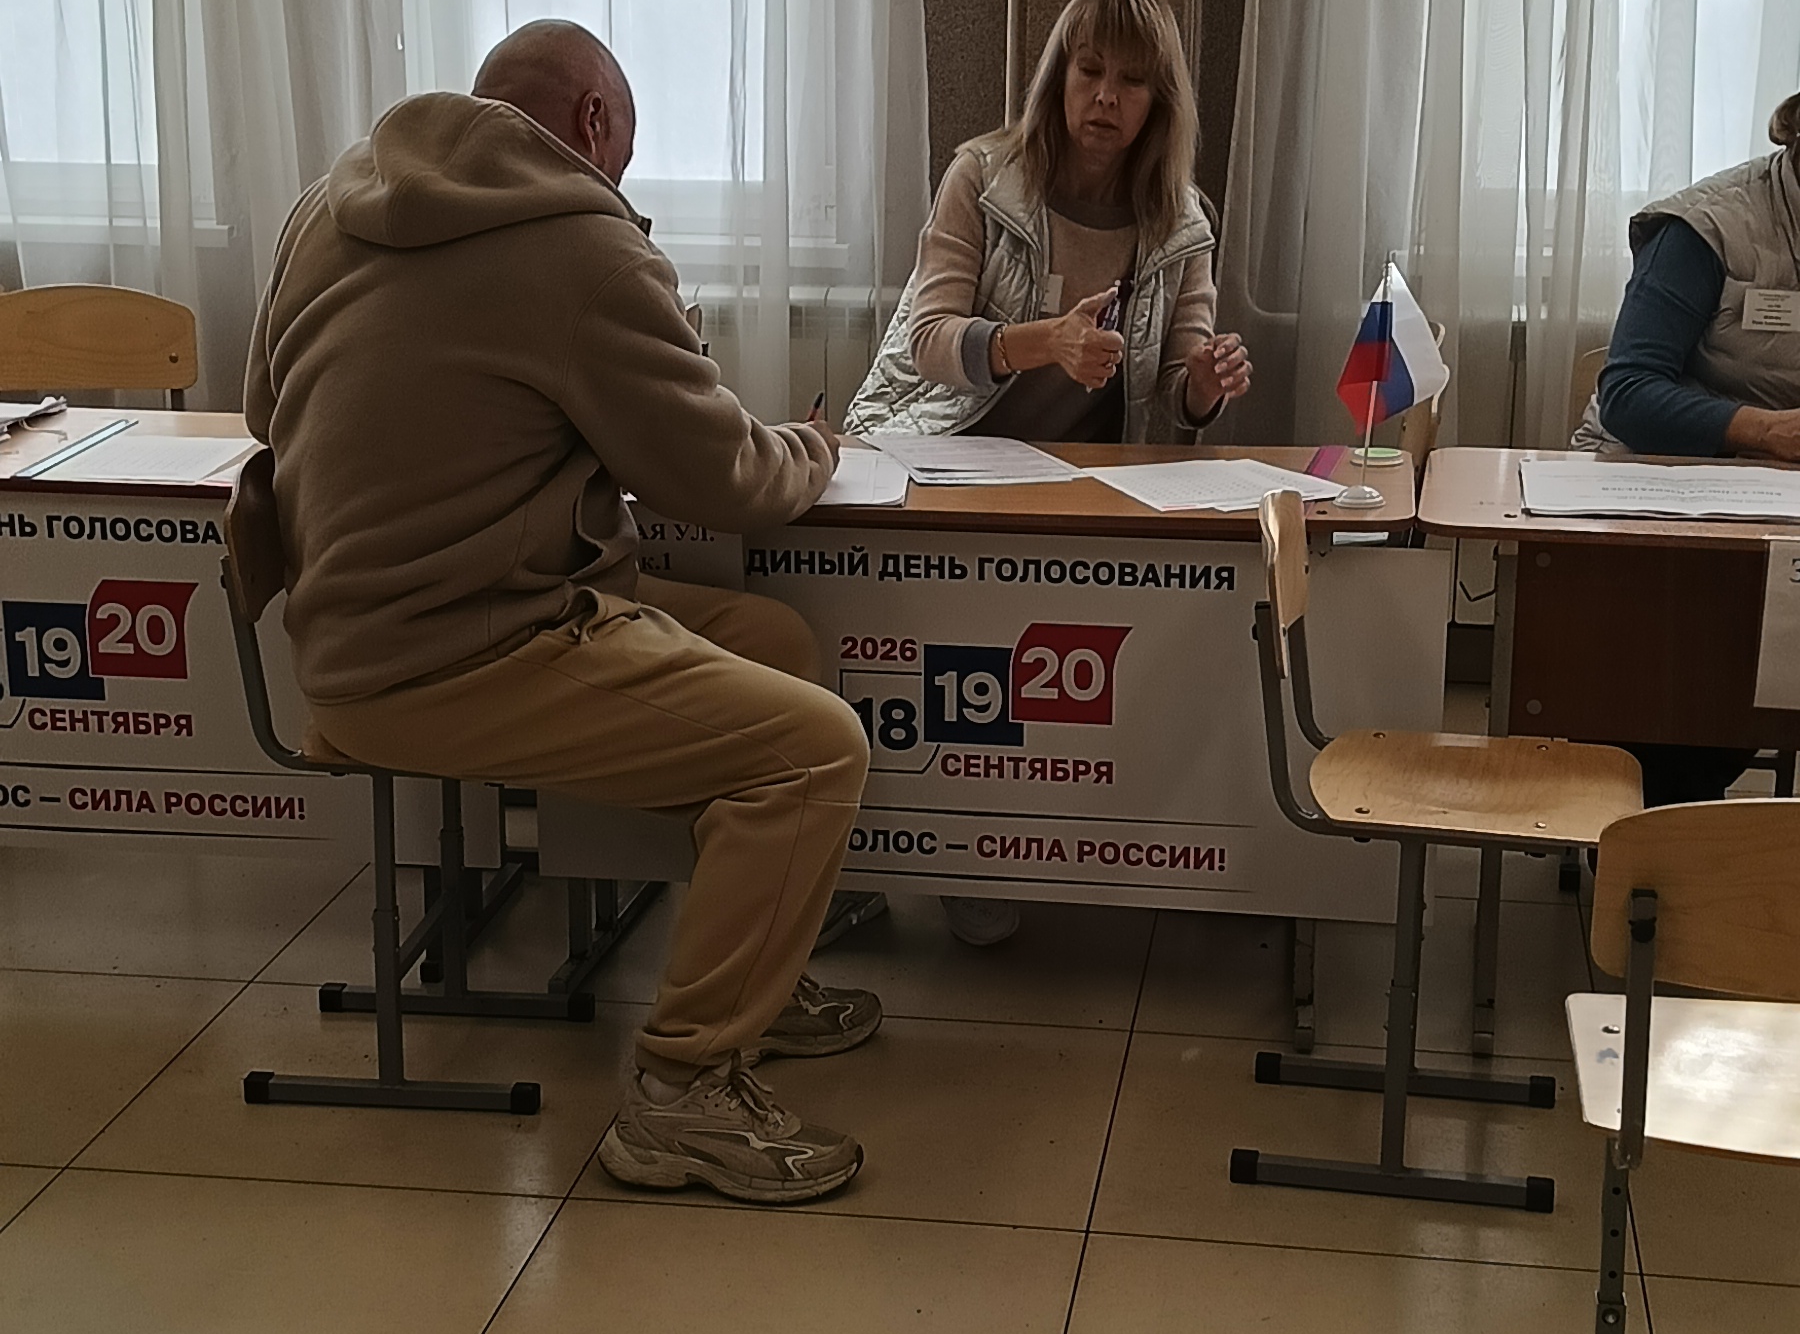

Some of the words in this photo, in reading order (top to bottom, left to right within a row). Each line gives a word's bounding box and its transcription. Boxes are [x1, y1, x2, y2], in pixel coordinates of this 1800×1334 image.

[0, 513, 38, 538] НЬ
[46, 515, 229, 545] ГОЛОСОВА
[746, 545, 869, 577] ДИНЫЙ
[878, 553, 969, 581] ДЕНЬ
[977, 556, 1235, 591] ГОЛОСОВАНИЯ
[95, 602, 178, 656] 20
[840, 636, 918, 662] 2026
[14, 626, 82, 679] 19
[1020, 646, 1106, 701] 20
[934, 670, 1003, 724] 19
[27, 707, 194, 737] СЕНТЯБРЯ
[940, 753, 1114, 785] СЕНТЯБРЯ
[68, 787, 156, 814] СИЛА
[164, 791, 306, 821] РОССИИ!
[847, 828, 938, 855] ОЛОС
[976, 834, 1068, 862] СИЛА
[1077, 840, 1226, 872] РОССИИ!
